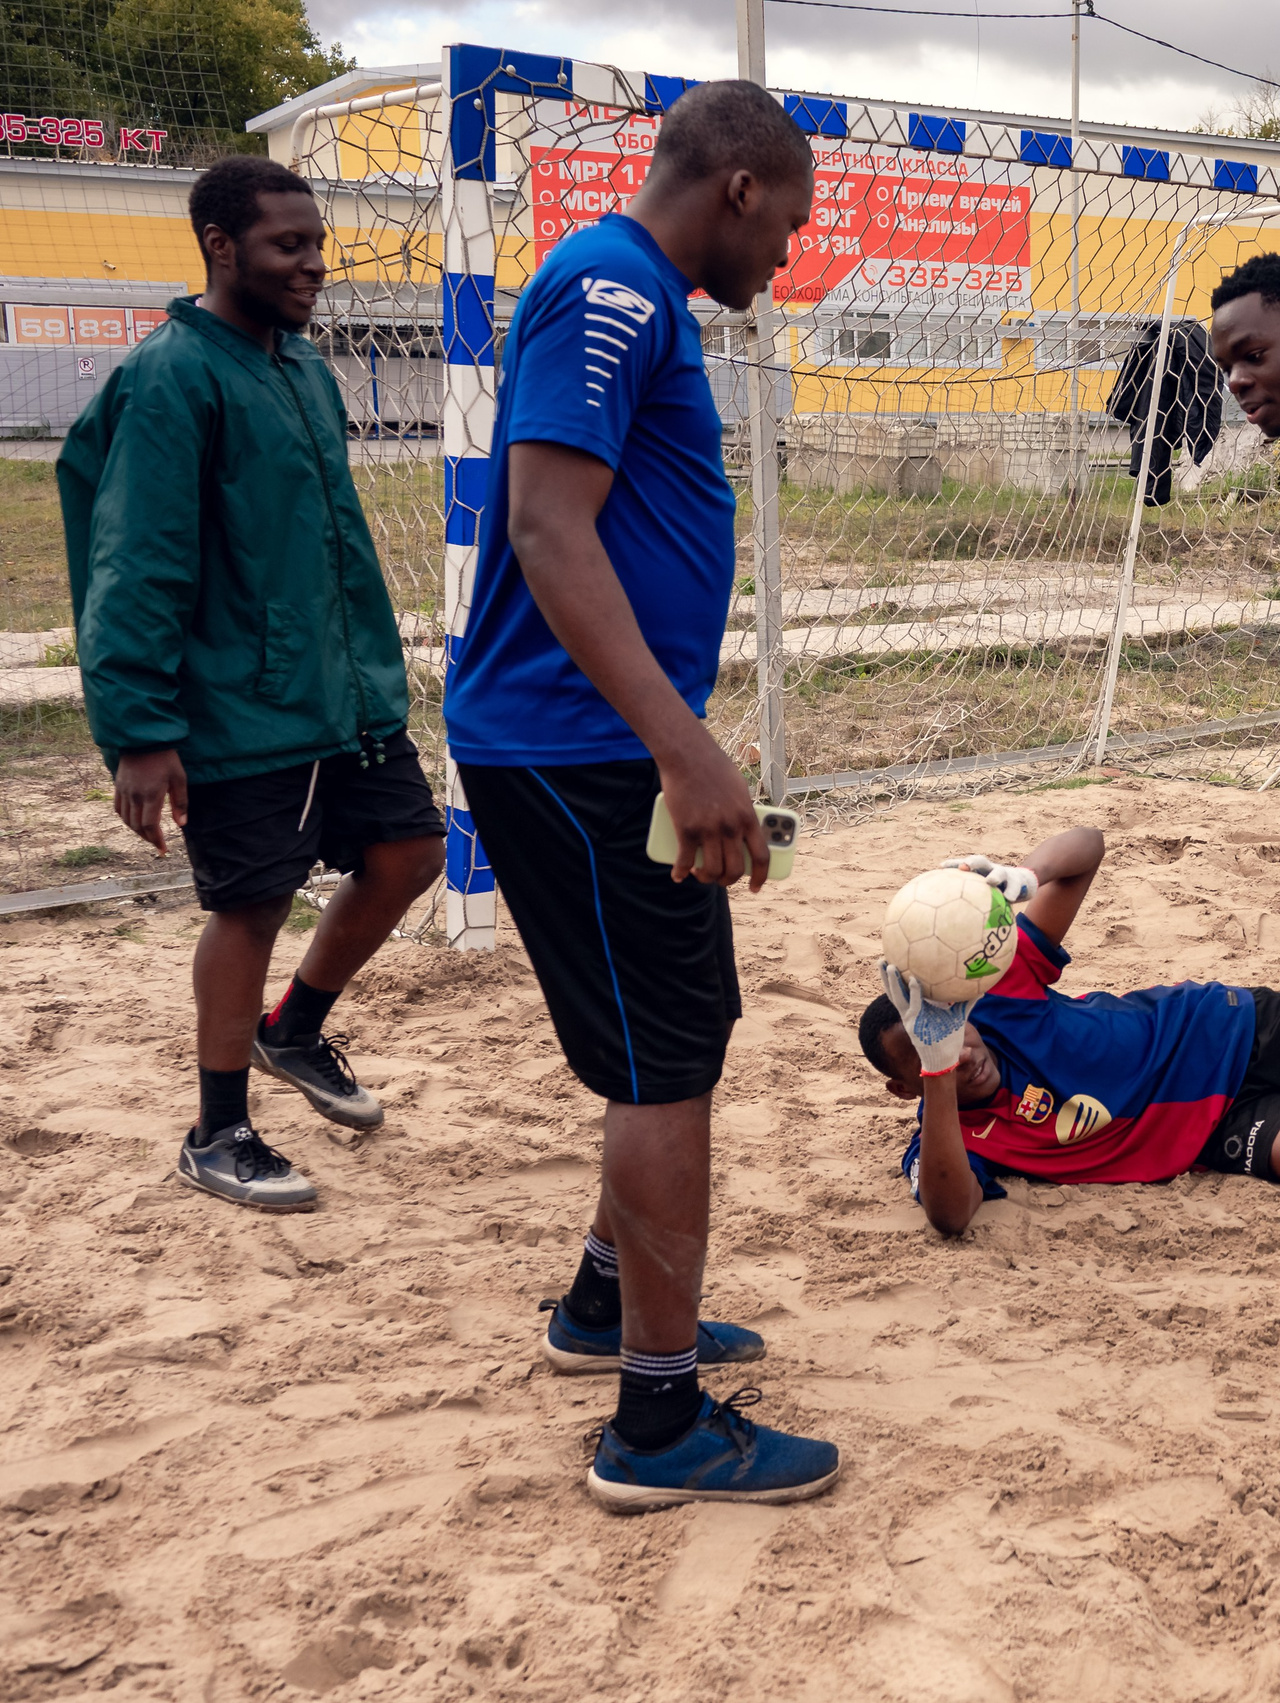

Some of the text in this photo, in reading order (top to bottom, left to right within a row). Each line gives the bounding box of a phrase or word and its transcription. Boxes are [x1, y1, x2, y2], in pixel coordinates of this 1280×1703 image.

[0, 113, 104, 147] 5-325
[558, 159, 612, 183] МРТ
[811, 150, 968, 177] ПЕРТНОГО КЛАССА
[815, 179, 855, 201] ЭЭГ
[892, 185, 1021, 214] Прием врачей
[815, 207, 857, 228] ЭКГ
[893, 212, 976, 236] Анализы
[817, 233, 861, 256] УЗИ
[887, 265, 1023, 292] 335-325
[774, 285, 1026, 310] ЕОБХОДИМА КОНСУЛЬТАЦИЯ СПЕЦИАЛИСТА
[20, 318, 66, 338] 59
[78, 319, 123, 339] 83
[1244, 1120, 1265, 1171] IADORA
